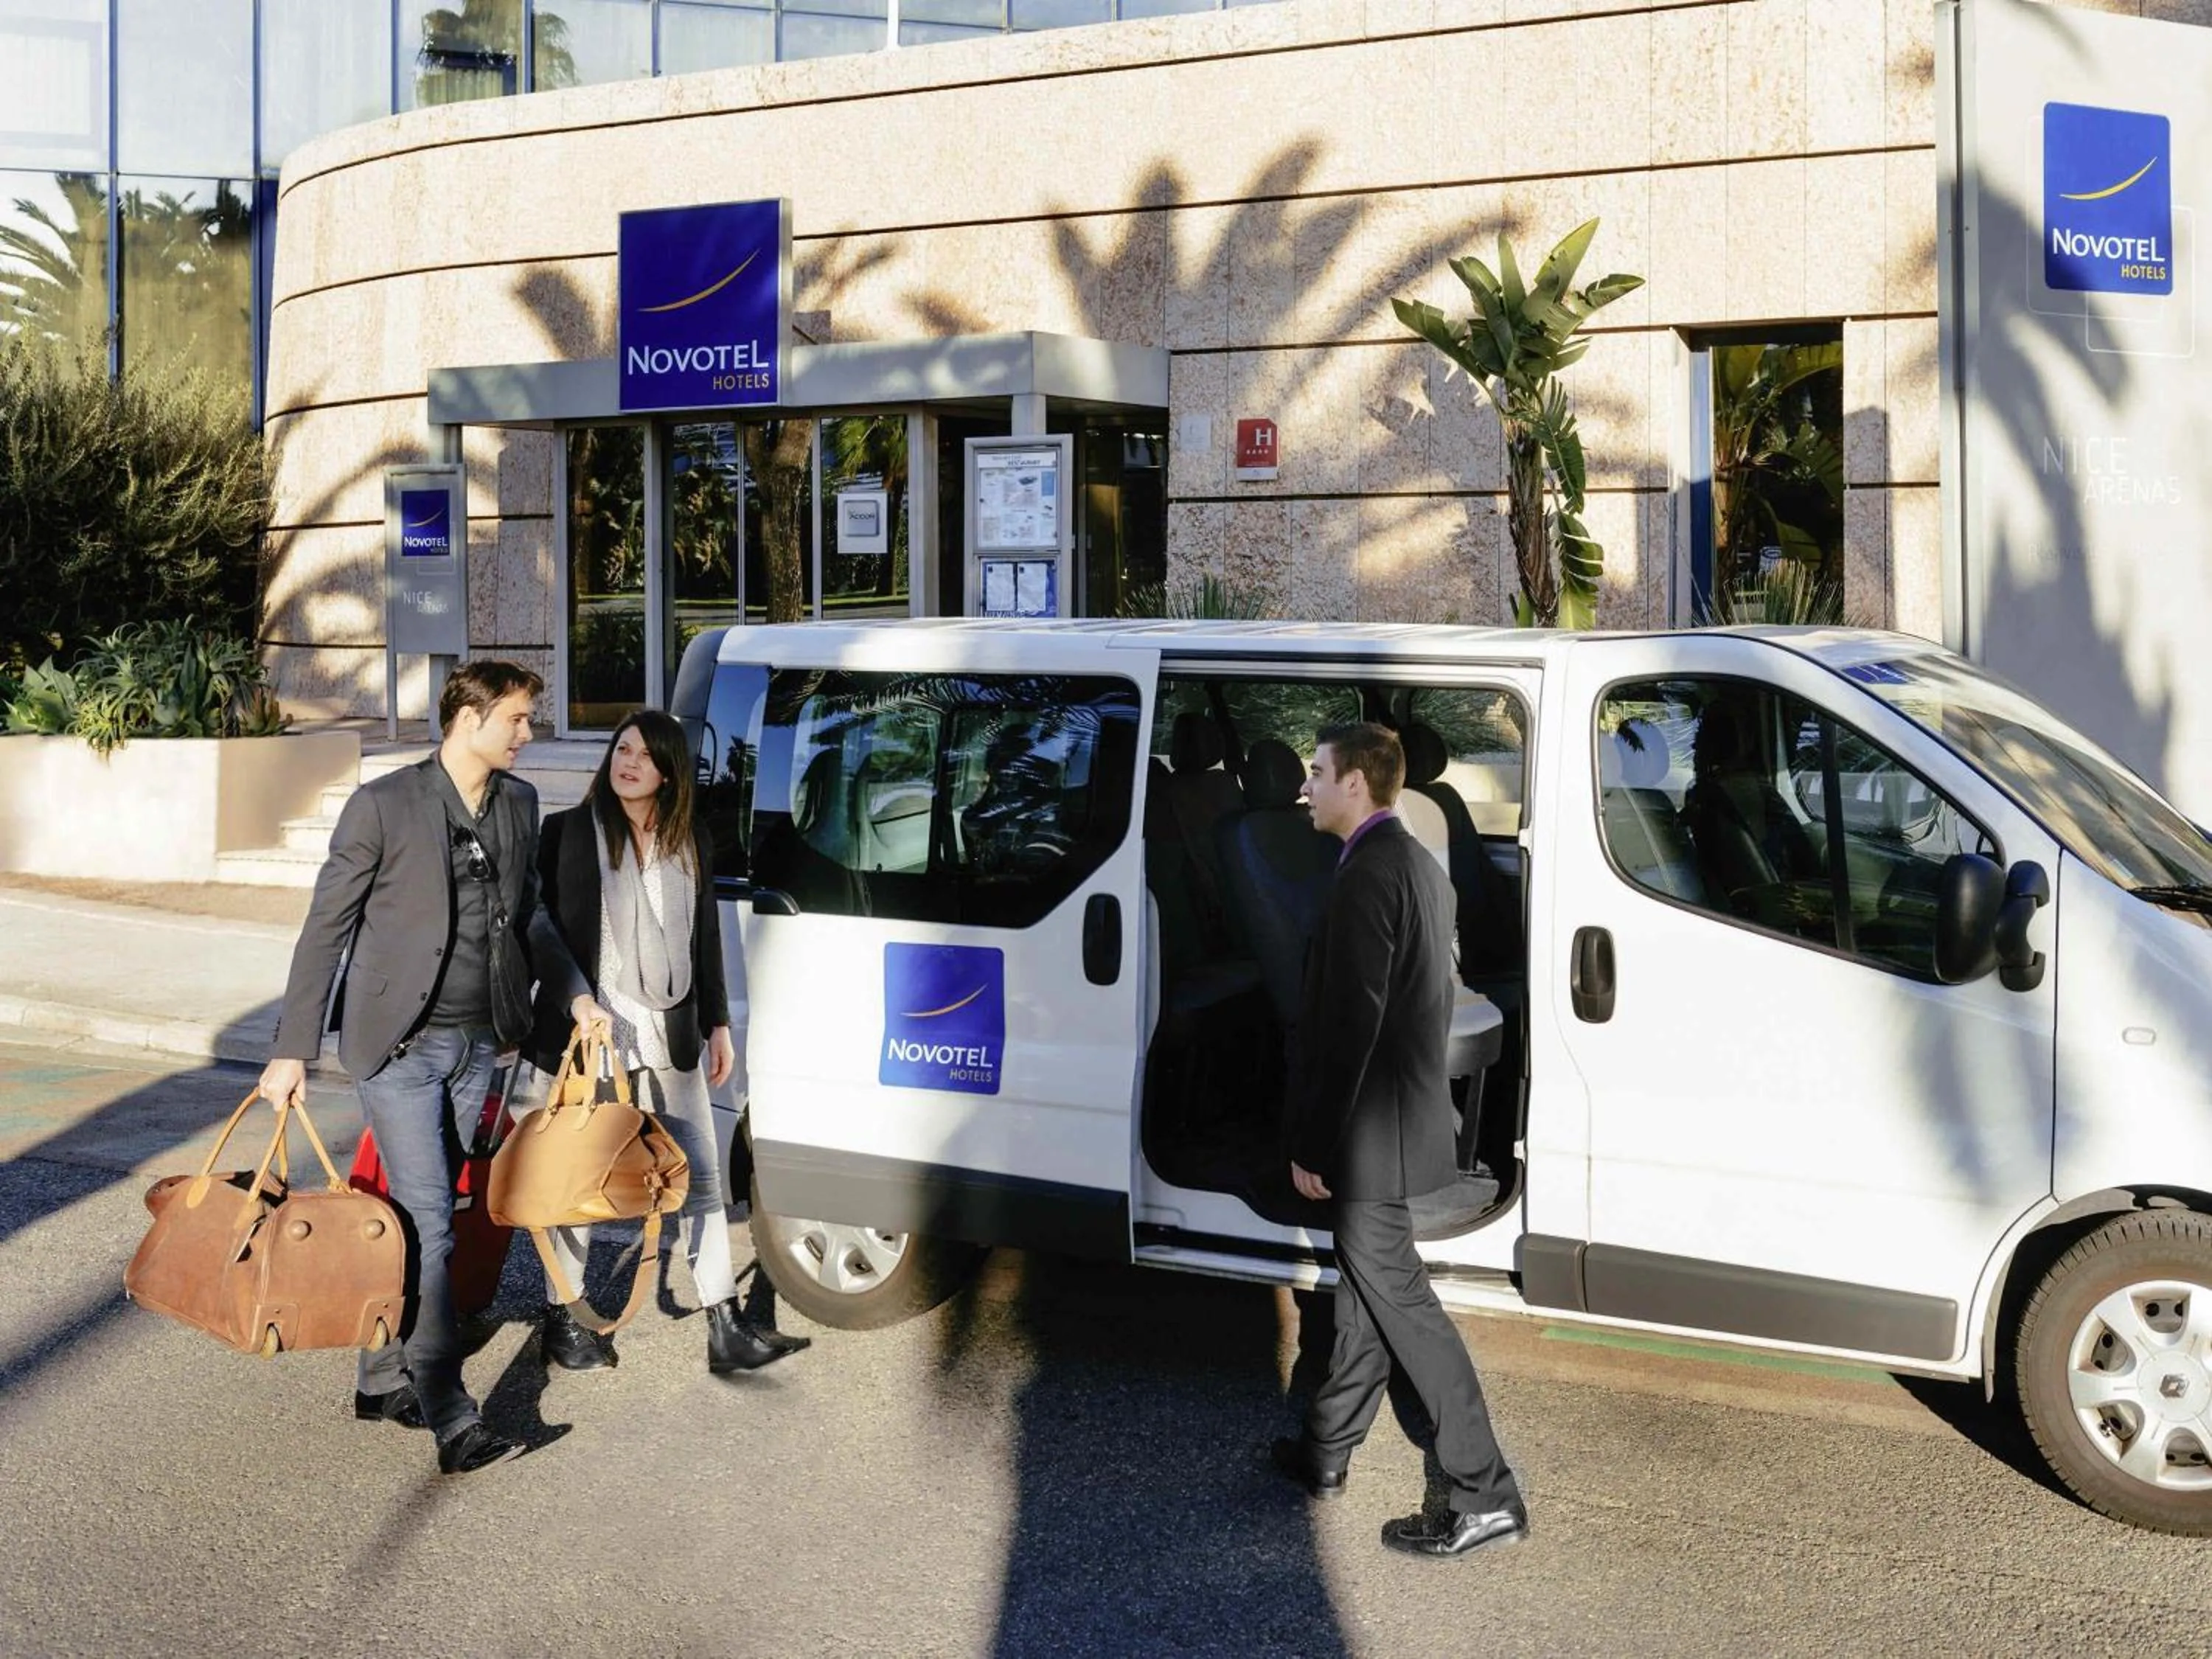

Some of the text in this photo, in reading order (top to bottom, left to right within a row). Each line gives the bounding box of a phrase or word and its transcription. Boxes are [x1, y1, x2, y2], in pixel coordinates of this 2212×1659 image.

[2053, 228, 2166, 262] NOVOTEL
[2121, 264, 2166, 280] HOTELS
[627, 339, 769, 375] NOVOTEL
[713, 372, 769, 389] HOTELS
[1256, 428, 1272, 446] H
[2043, 437, 2126, 475] NICE
[2083, 476, 2181, 505] ARENAS
[404, 536, 448, 547] NOVOTEL
[403, 591, 432, 605] NICE
[888, 1038, 993, 1068] NOVOTEL
[949, 1068, 992, 1082] HOTELS
